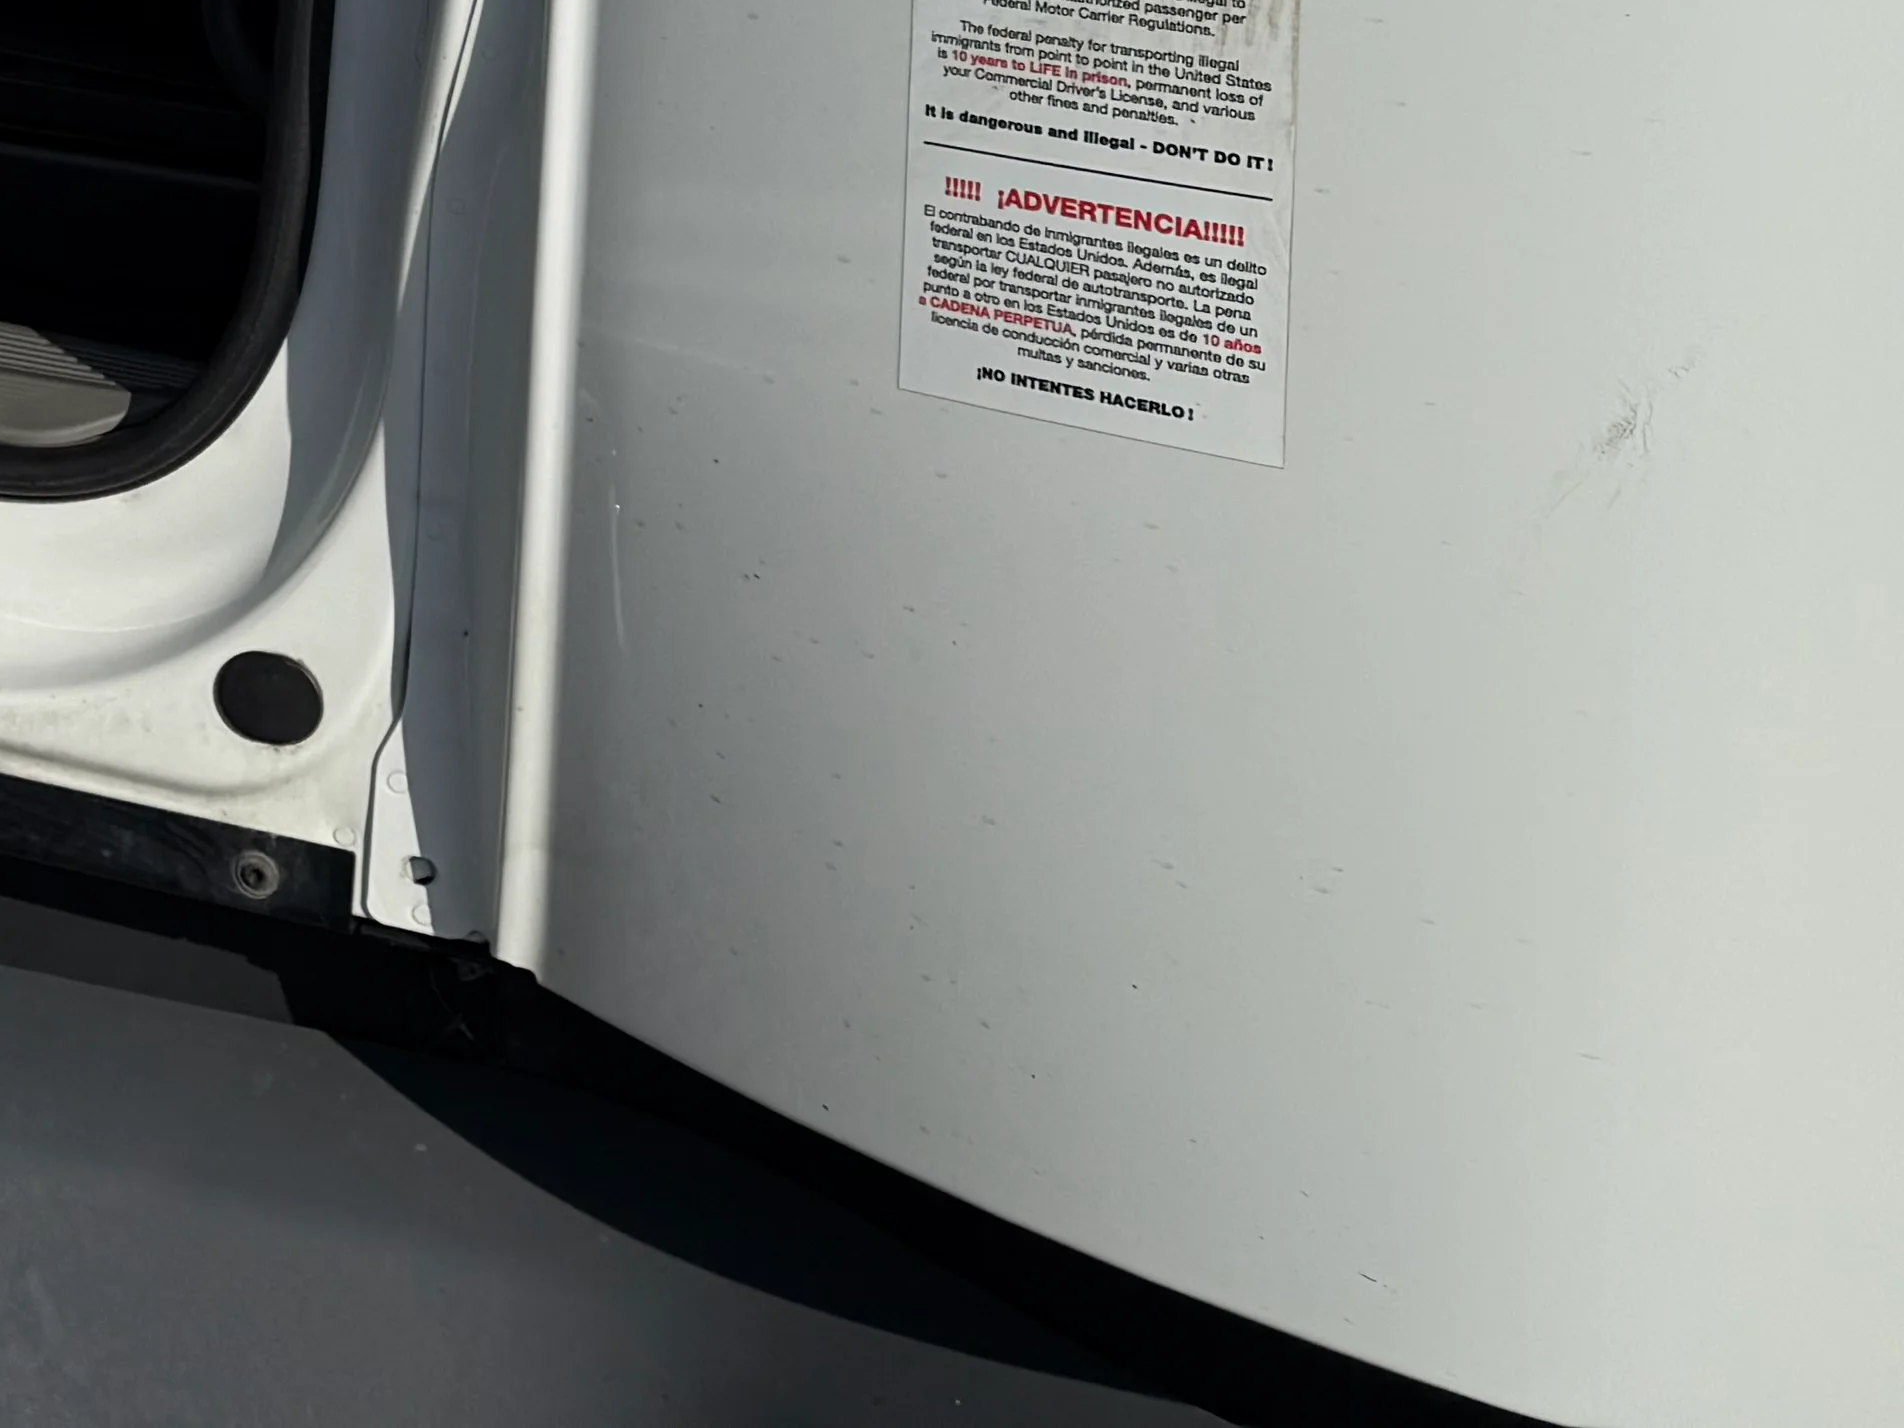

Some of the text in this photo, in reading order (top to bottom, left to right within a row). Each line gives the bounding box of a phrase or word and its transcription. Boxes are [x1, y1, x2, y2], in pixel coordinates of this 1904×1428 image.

[1034, 0, 1076, 17] Motor
[1077, 6, 1125, 24] Carrier
[1127, 12, 1216, 37] Regulations.
[1143, 2, 1219, 21] passenger
[1221, 12, 1248, 25] per
[930, 30, 1272, 92] immigrants from point to point in the United States
[959, 19, 1239, 72] The federal penalty for transporting illegal
[937, 46, 1264, 107] is 10 years to LIFE in prison, permanent loss of
[942, 64, 972, 78] your
[973, 67, 1053, 91] Commercial
[1109, 87, 1168, 110] License,
[1171, 99, 1200, 113] and
[1202, 104, 1256, 121] various
[924, 103, 937, 118] It
[958, 109, 1043, 135] dangerous
[1047, 127, 1079, 142] and
[1152, 140, 1209, 162] DON'T
[1213, 149, 1241, 166] DO
[1008, 89, 1179, 126] other fines and penalties.
[923, 203, 936, 217] El
[938, 209, 1021, 234] contrabando
[1022, 223, 1042, 237] de
[1182, 253, 1201, 265] es
[1203, 256, 1223, 269] un
[1225, 258, 1267, 276] delito
[929, 220, 974, 240] federal
[975, 231, 993, 244] en
[995, 232, 1016, 248] los
[1018, 236, 1073, 258] Estados
[1076, 247, 1129, 268] Unidos.
[1198, 271, 1217, 284] es
[931, 235, 1255, 306] transportar CUALQUIER pasajero no autorizado
[930, 310, 979, 332] licencia
[981, 322, 999, 336] de
[1082, 344, 1151, 366] comercial
[1153, 357, 1163, 370] y
[1166, 359, 1209, 377] varias
[1212, 368, 1250, 384] otras
[1017, 346, 1151, 382] multas y sanciones.
[1010, 371, 1095, 401] INTENTES
